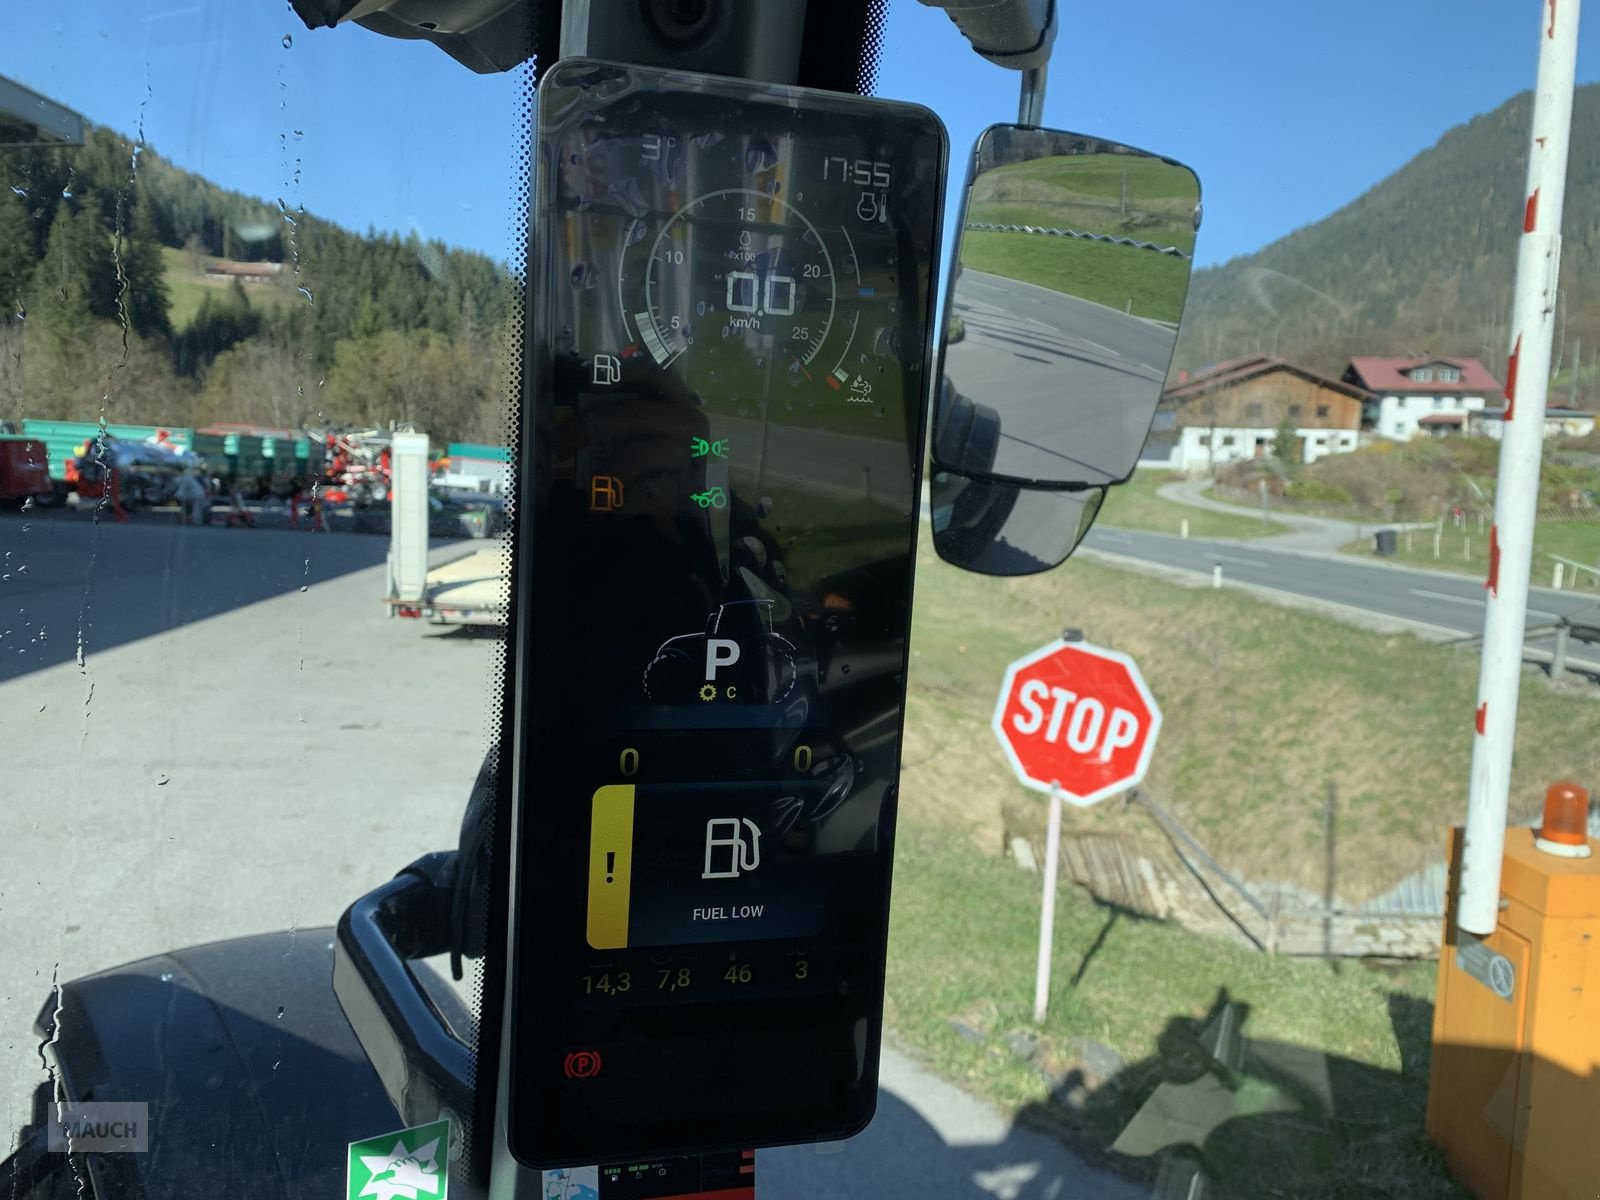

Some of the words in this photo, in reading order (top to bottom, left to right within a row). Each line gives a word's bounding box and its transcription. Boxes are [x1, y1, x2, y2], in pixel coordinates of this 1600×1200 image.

[823, 156, 890, 187] 17:55
[739, 207, 755, 222] 15
[666, 251, 684, 265] 10
[803, 264, 821, 278] 20
[671, 315, 680, 329] 5
[729, 316, 760, 329] km/h
[791, 327, 810, 341] 25
[705, 639, 740, 681] P
[1013, 679, 1139, 763] STOP
[620, 748, 639, 776] 0
[794, 745, 812, 772] 0
[692, 907, 728, 920] FUEL
[732, 905, 764, 918] LOW
[657, 968, 691, 991] 7,8
[724, 964, 751, 984] 46
[795, 961, 808, 980] 3
[582, 973, 631, 995] 14,3
